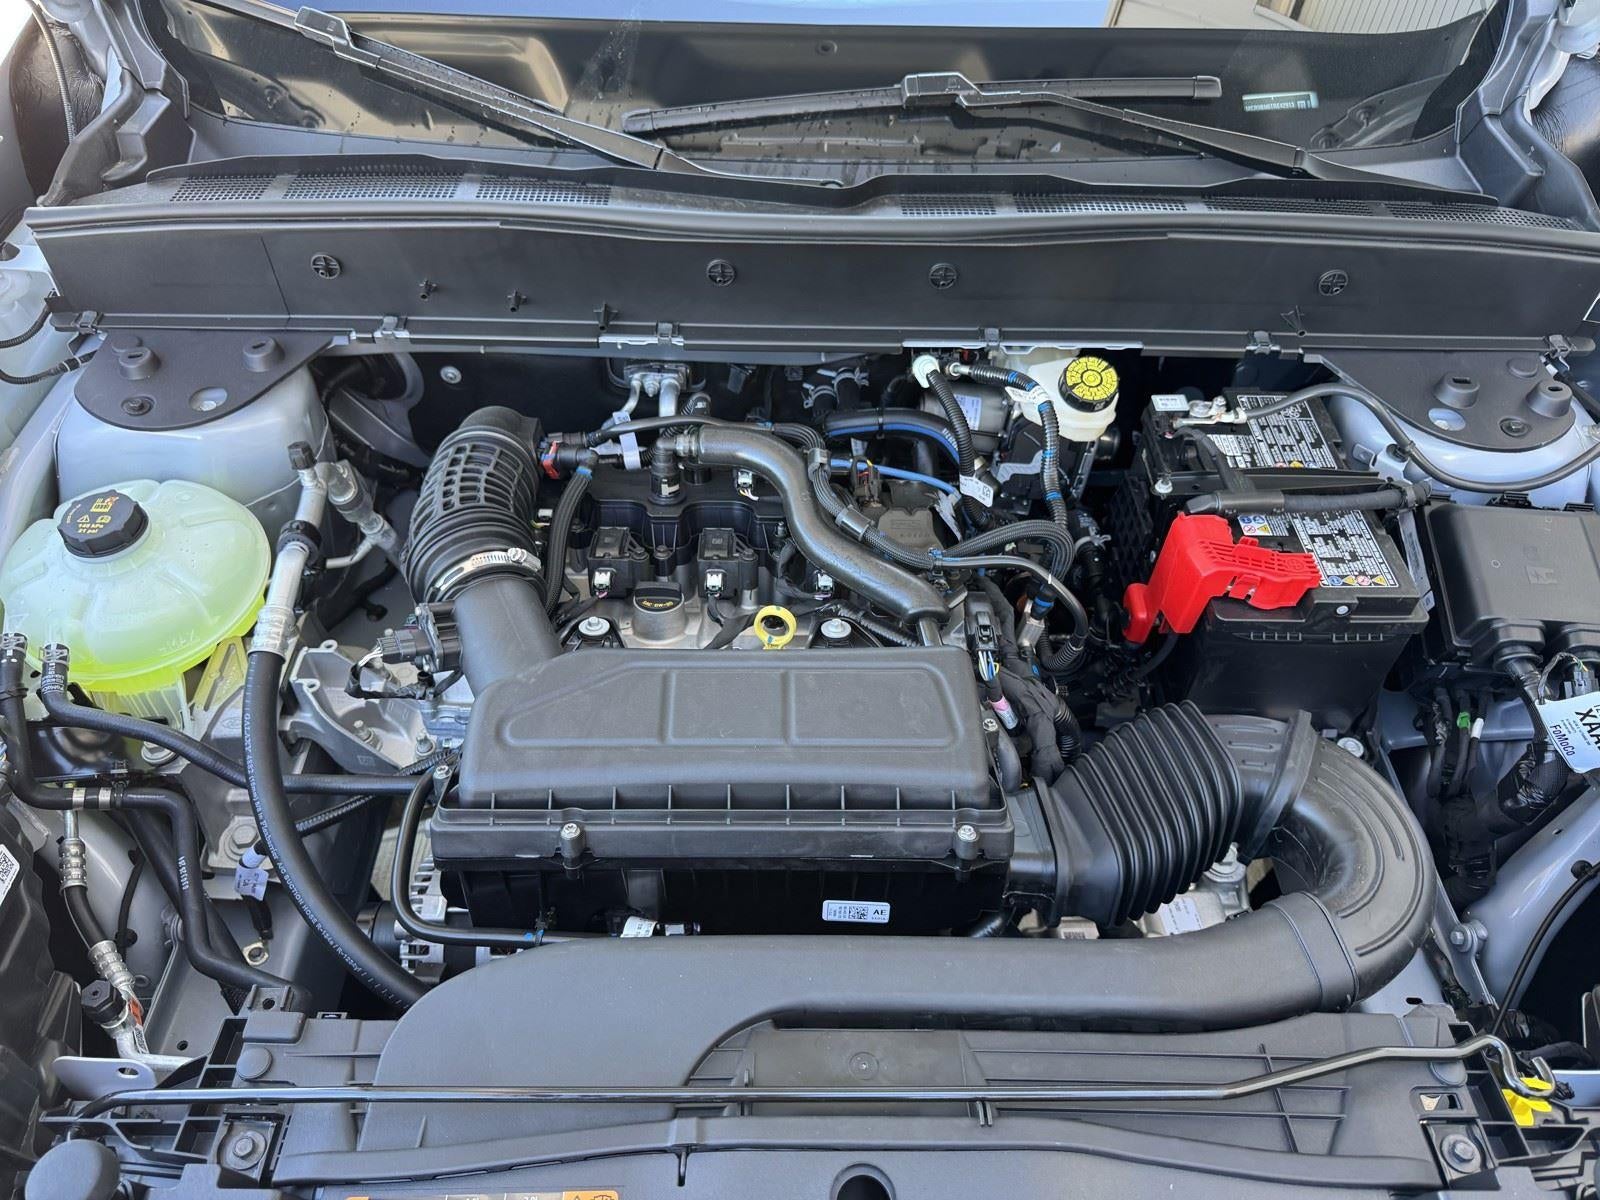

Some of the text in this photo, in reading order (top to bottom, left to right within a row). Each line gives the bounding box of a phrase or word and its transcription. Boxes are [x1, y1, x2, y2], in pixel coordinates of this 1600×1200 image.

[1550, 724, 1576, 756] FoMoCo
[276, 862, 286, 874] A/C
[284, 874, 304, 905] SUCTION
[303, 904, 318, 924] HOSE
